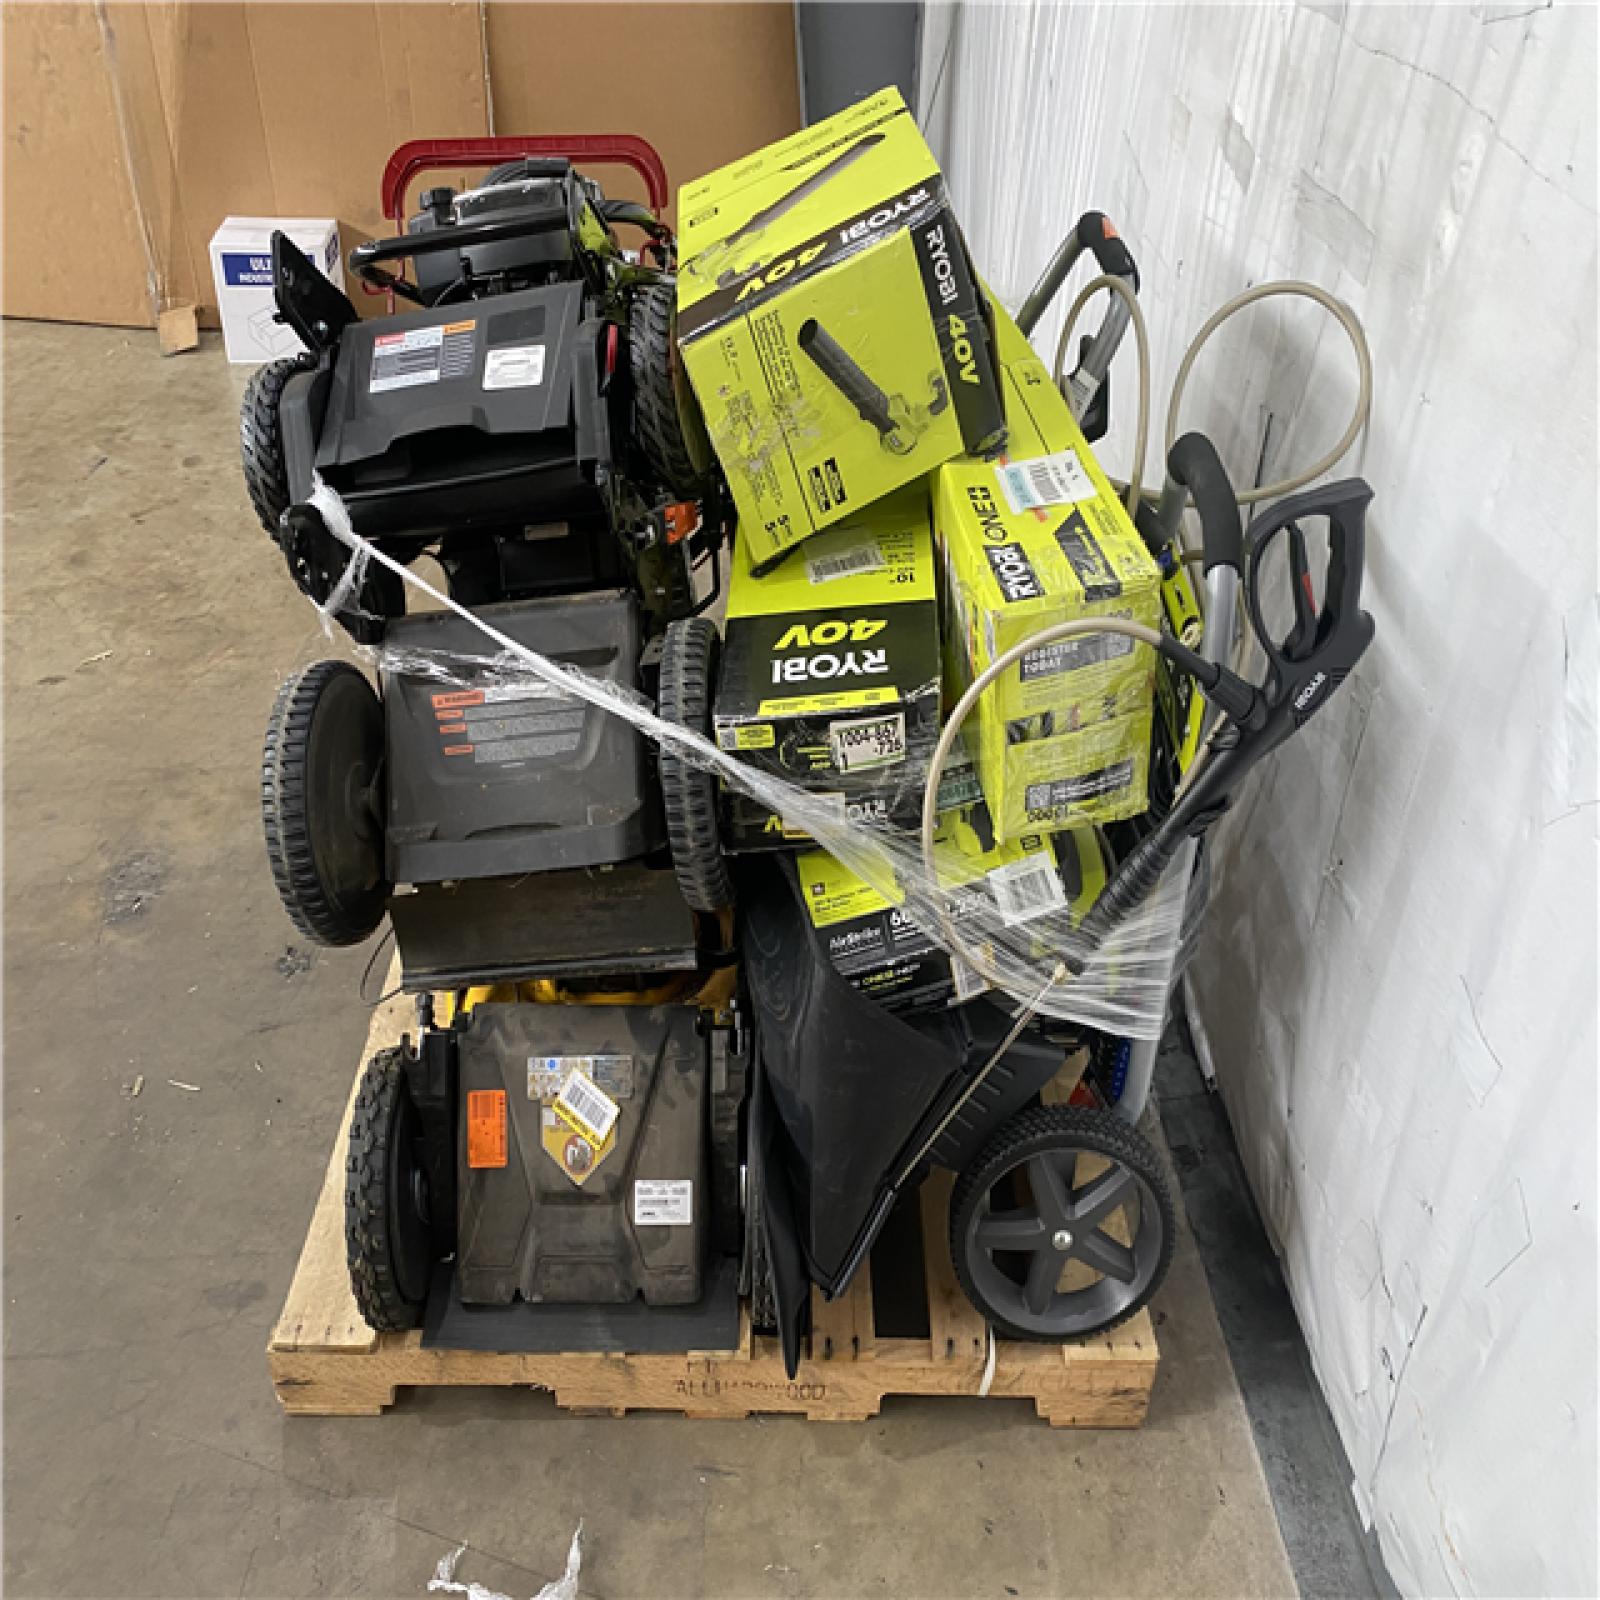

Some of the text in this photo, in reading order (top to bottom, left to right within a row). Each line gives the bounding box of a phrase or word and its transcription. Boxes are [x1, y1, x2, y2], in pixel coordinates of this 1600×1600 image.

[734, 189, 931, 303] RYOBI 40V
[924, 224, 981, 386] RYOBI 40V
[990, 543, 1043, 600] RYOBI
[772, 618, 889, 652] 40V
[771, 649, 889, 684] RYOBI
